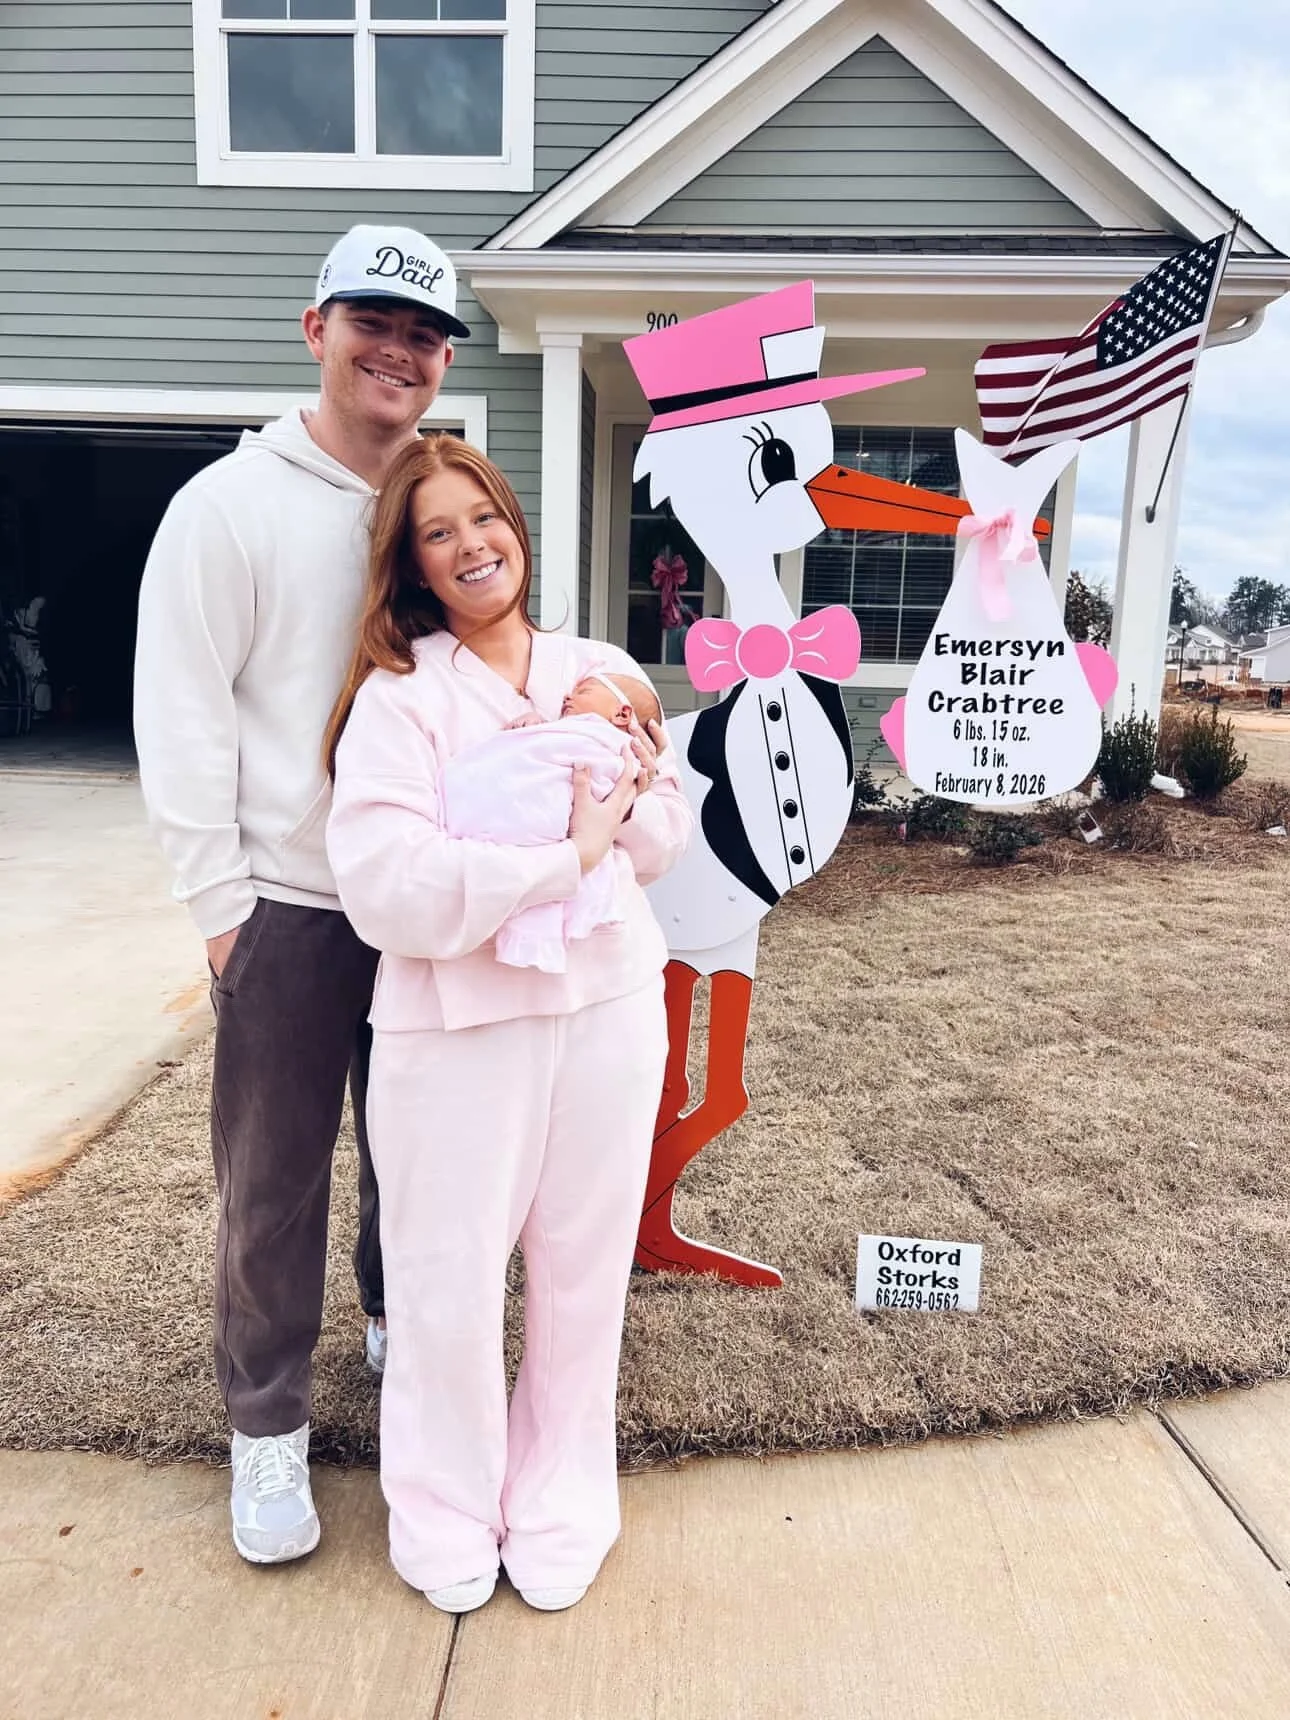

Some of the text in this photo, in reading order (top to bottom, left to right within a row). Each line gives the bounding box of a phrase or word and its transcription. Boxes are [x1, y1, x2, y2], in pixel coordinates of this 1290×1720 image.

[366, 246, 444, 293] Dad
[406, 256, 432, 274] GIRL
[935, 634, 1065, 660] Emersyn
[961, 663, 1035, 685] Blair
[928, 690, 1064, 714] Crabtree
[953, 719, 1030, 741] 6 lbs. 15 oz.
[973, 746, 1008, 768] 18 in.
[935, 772, 1046, 797] February 8, 2026
[878, 1241, 961, 1266] Oxford
[877, 1266, 959, 1289] Storks
[876, 1287, 959, 1311] 662-259-0562
